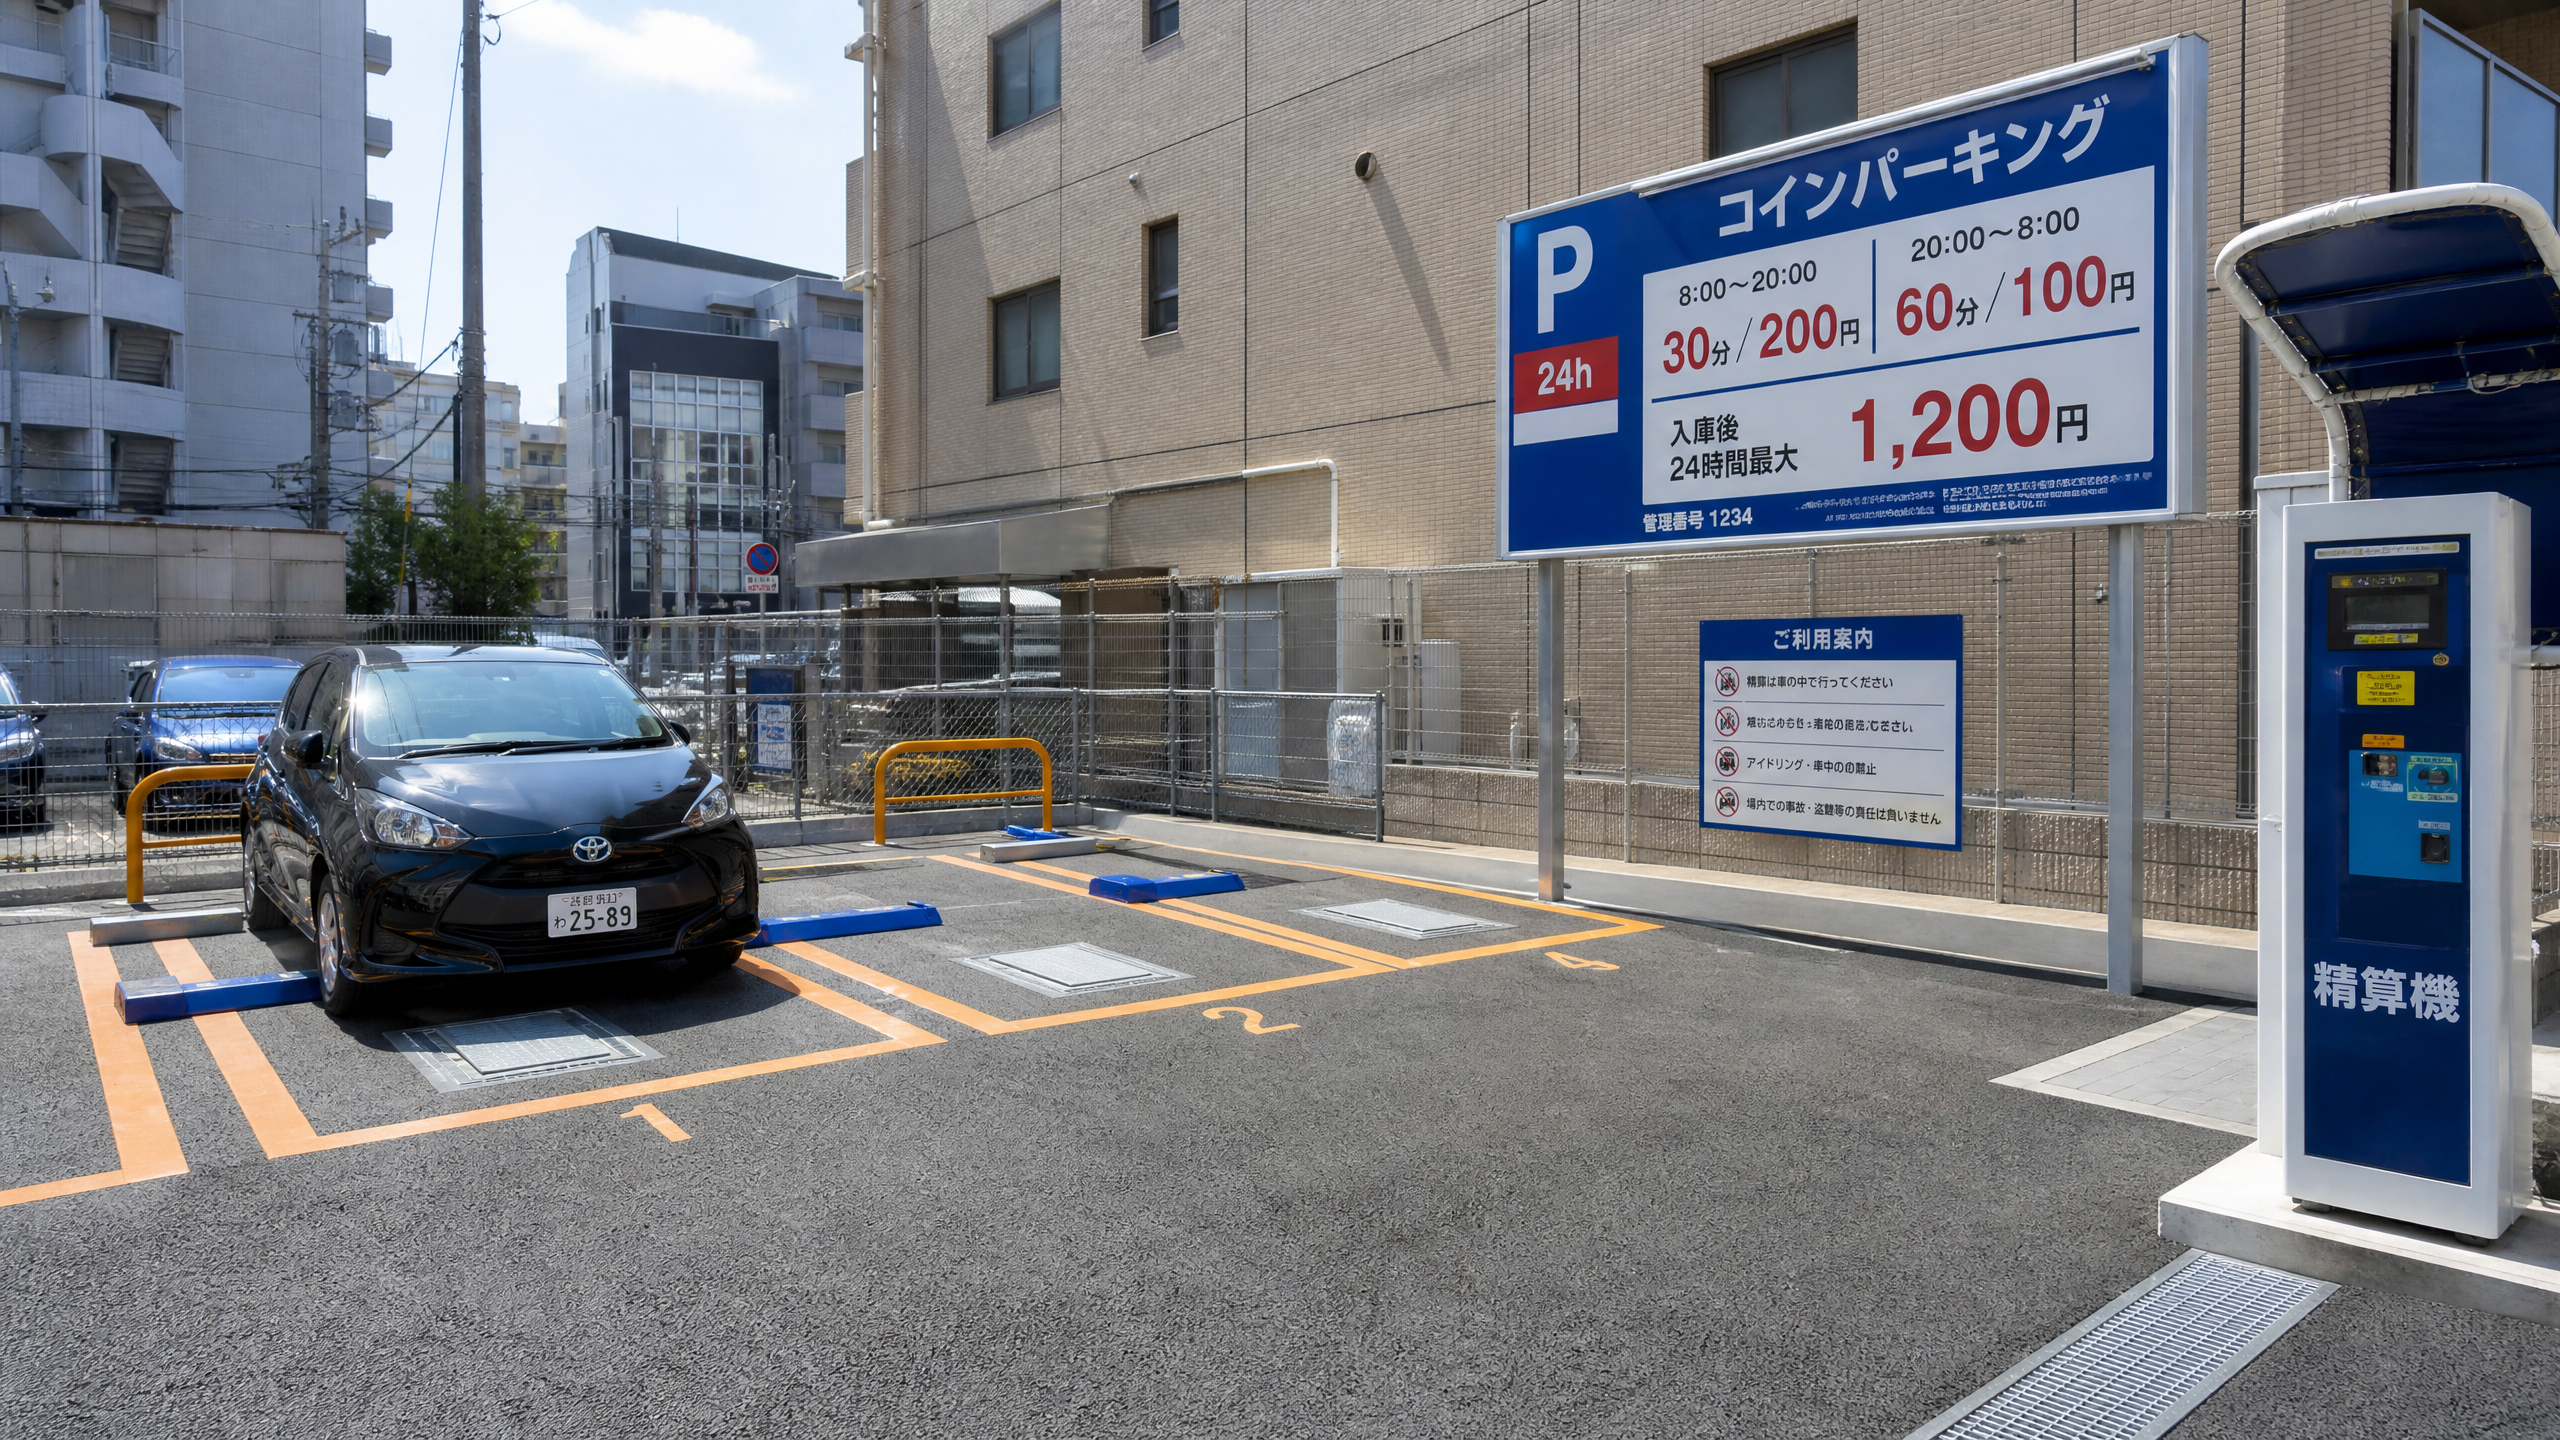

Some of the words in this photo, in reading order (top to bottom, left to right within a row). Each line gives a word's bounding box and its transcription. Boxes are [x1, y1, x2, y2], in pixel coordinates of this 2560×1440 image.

[1719, 94, 2111, 237] コインパーキング
[1538, 226, 1593, 334] P
[1537, 357, 1592, 396] 24h
[1670, 414, 1739, 447] 入庫後
[1851, 377, 2089, 470] 1,200円
[1670, 442, 1799, 482] 24時間最大
[1643, 510, 1704, 533] 管理番号
[1709, 507, 1753, 527] 1234
[1773, 627, 1873, 651] ご利用案内
[554, 916, 566, 929] わ
[569, 905, 632, 932] 25-89
[2313, 960, 2461, 1024] 精算機
[1202, 1006, 1301, 1035] 2
[619, 1102, 692, 1143] 1
